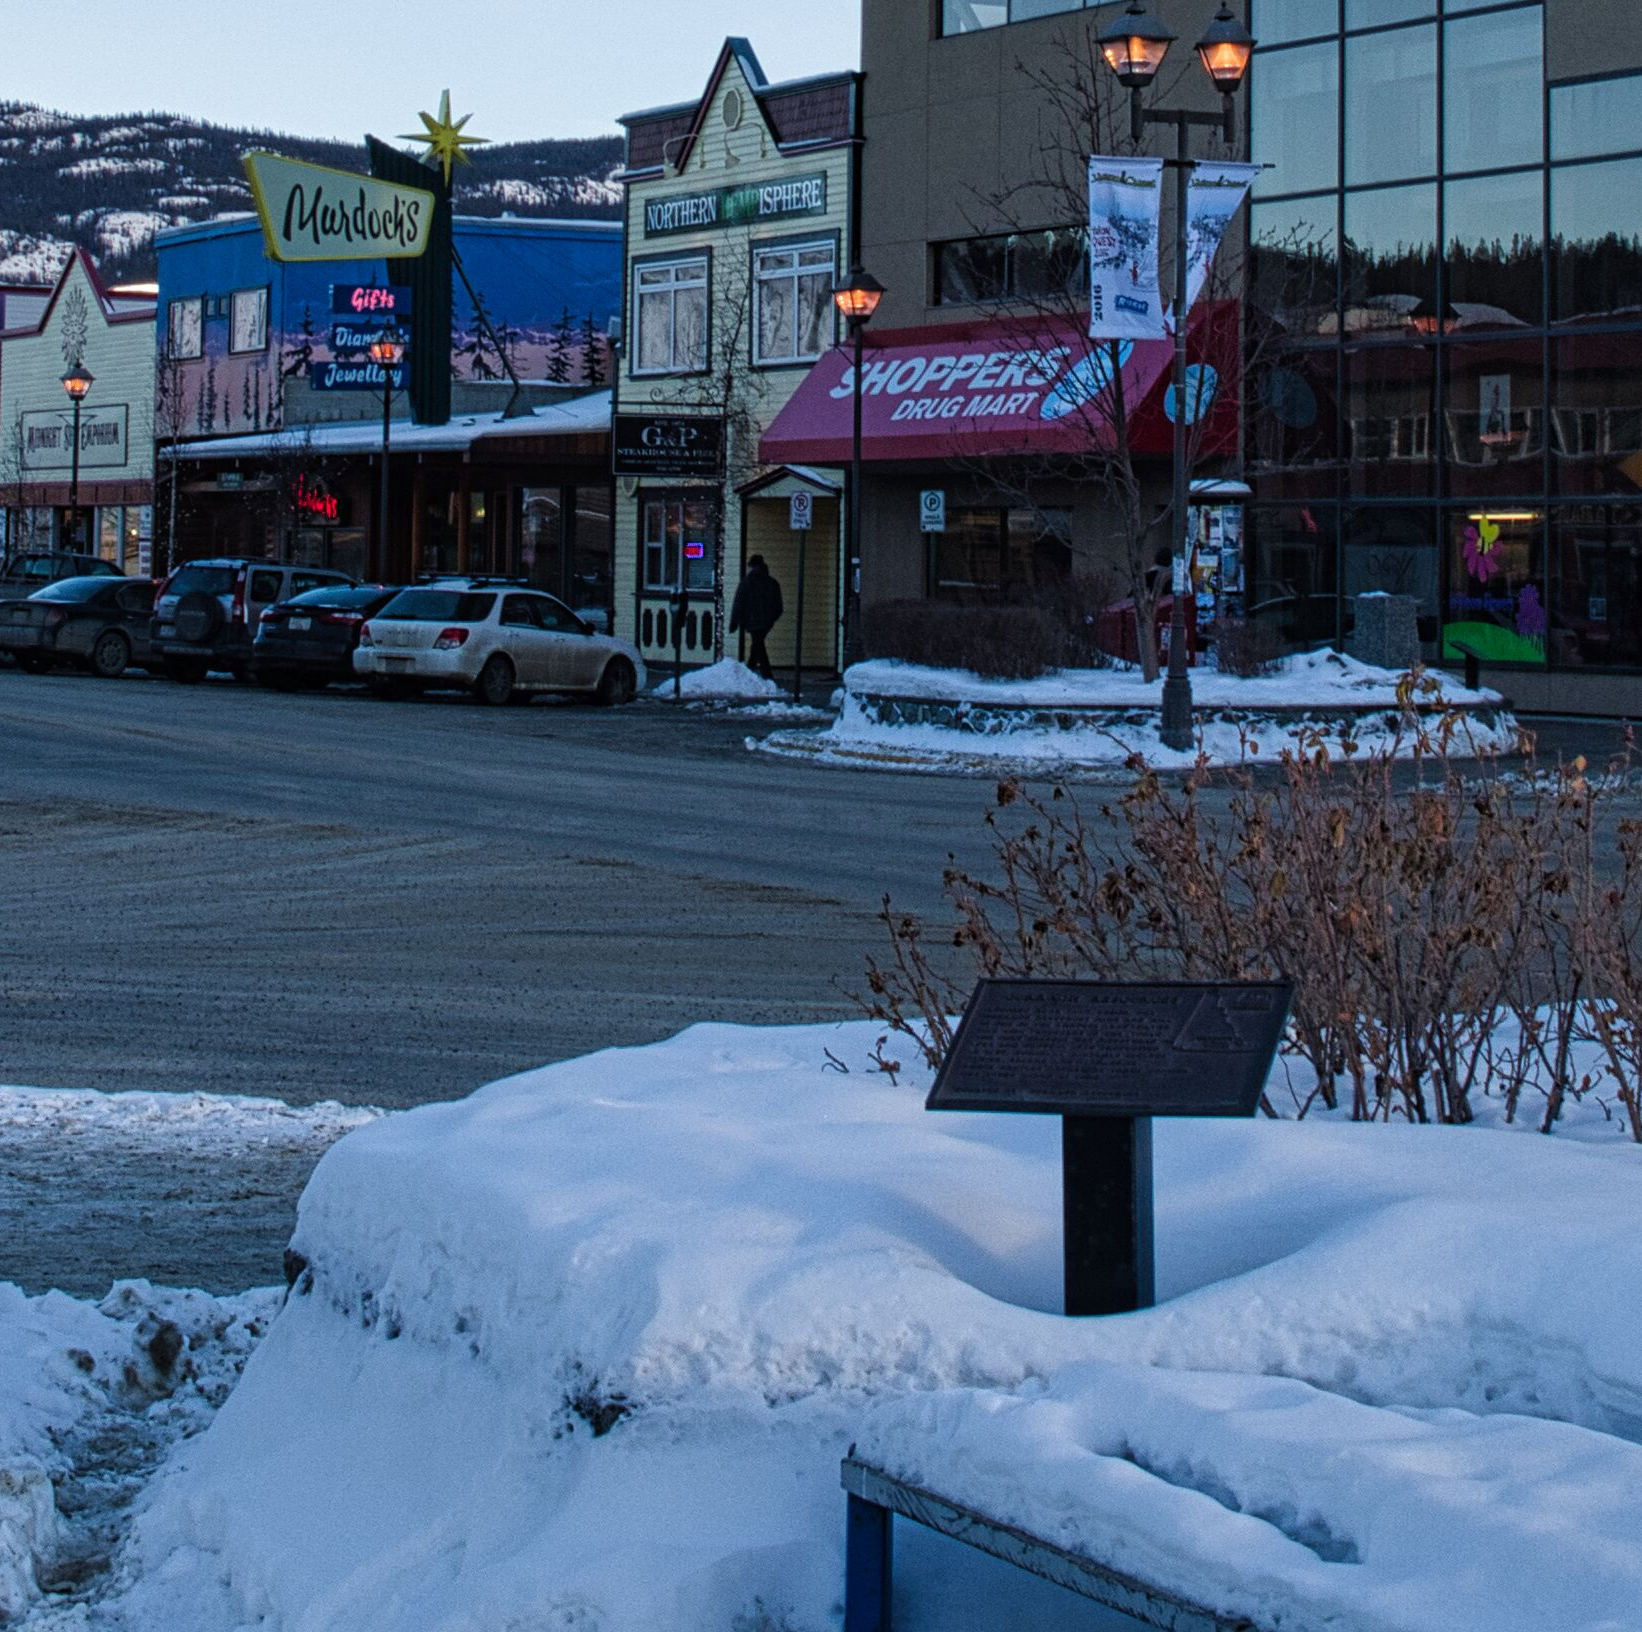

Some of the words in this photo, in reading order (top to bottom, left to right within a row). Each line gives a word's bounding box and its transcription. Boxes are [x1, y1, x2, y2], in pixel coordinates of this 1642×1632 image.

[283, 183, 420, 248] Murdoch's
[647, 196, 717, 231] NORTHERN
[350, 287, 395, 313] Gifts
[1094, 284, 1103, 322] 2016
[335, 325, 411, 348] Diams
[325, 363, 403, 388] Jewelley
[830, 346, 1071, 399] SHOPPERS
[891, 397, 961, 421] DRUG
[962, 392, 1040, 418] MART
[641, 426, 699, 448] G&P
